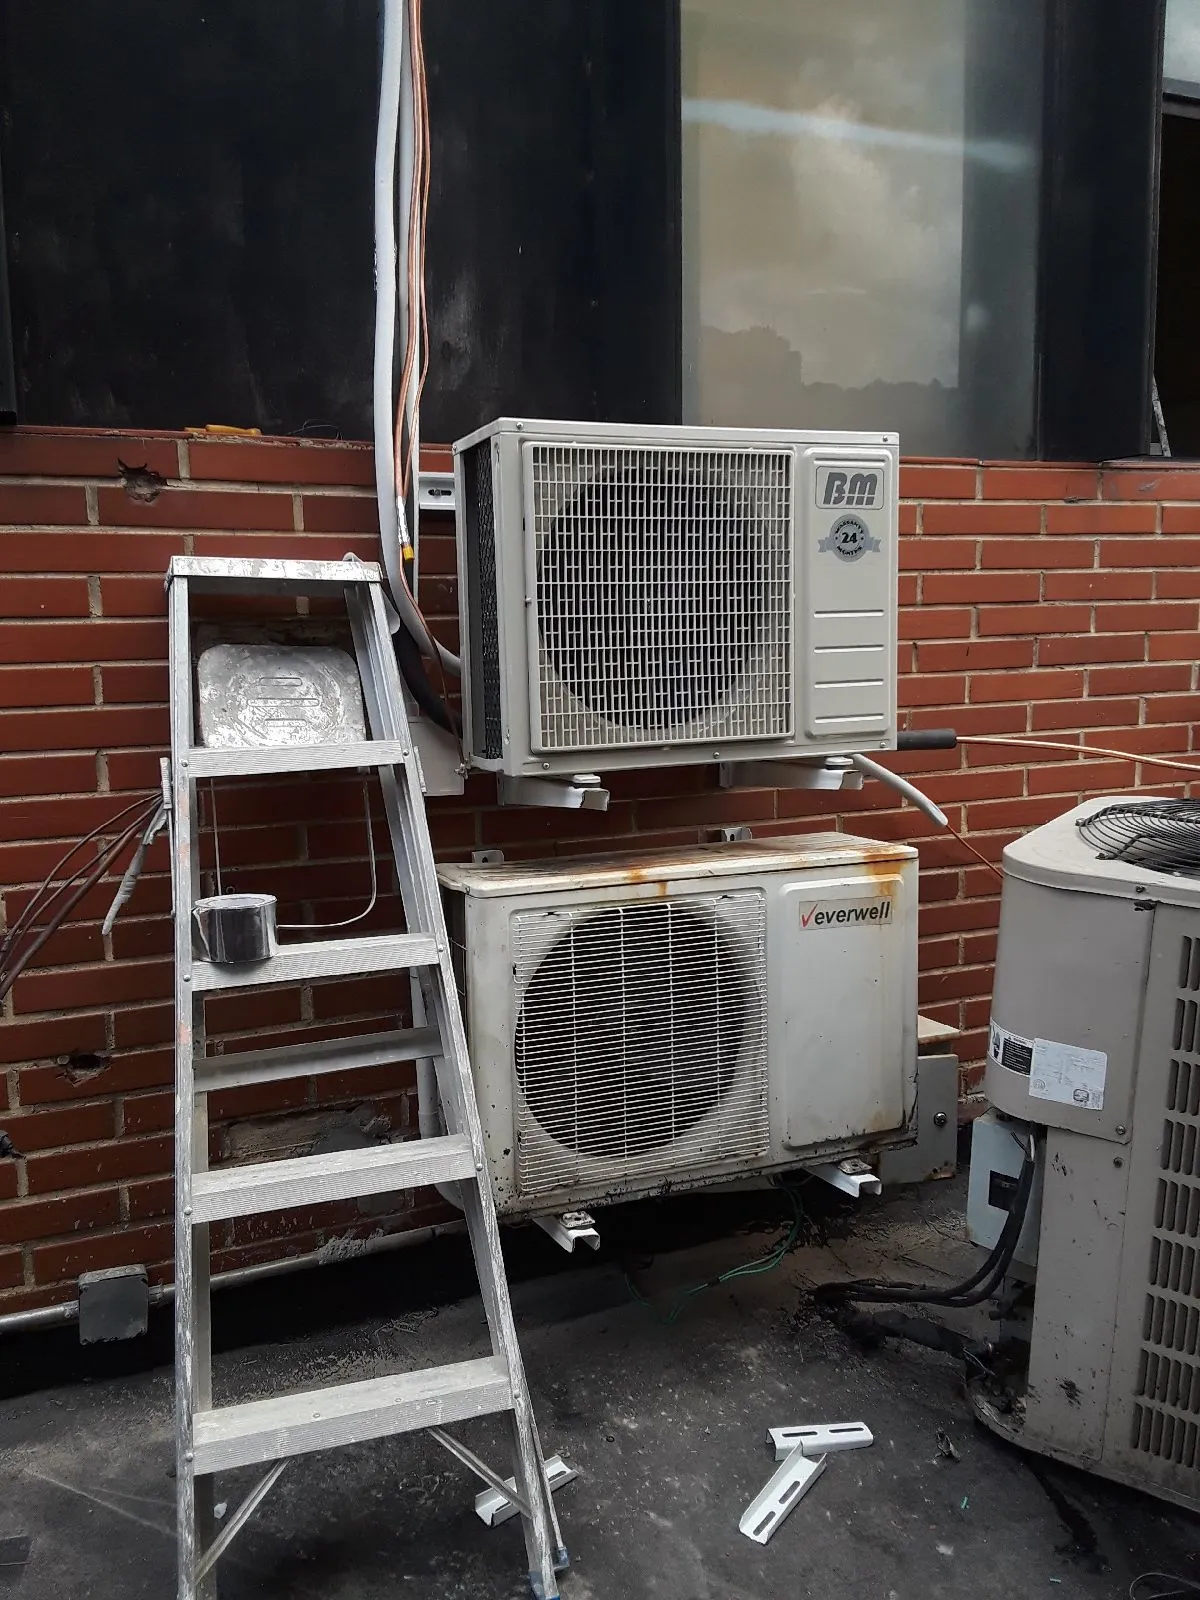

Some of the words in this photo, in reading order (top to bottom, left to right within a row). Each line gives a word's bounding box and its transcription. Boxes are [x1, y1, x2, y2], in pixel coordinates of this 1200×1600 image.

[823, 472, 877, 506] BM
[841, 532, 858, 544] 24
[814, 901, 891, 925] everwell
